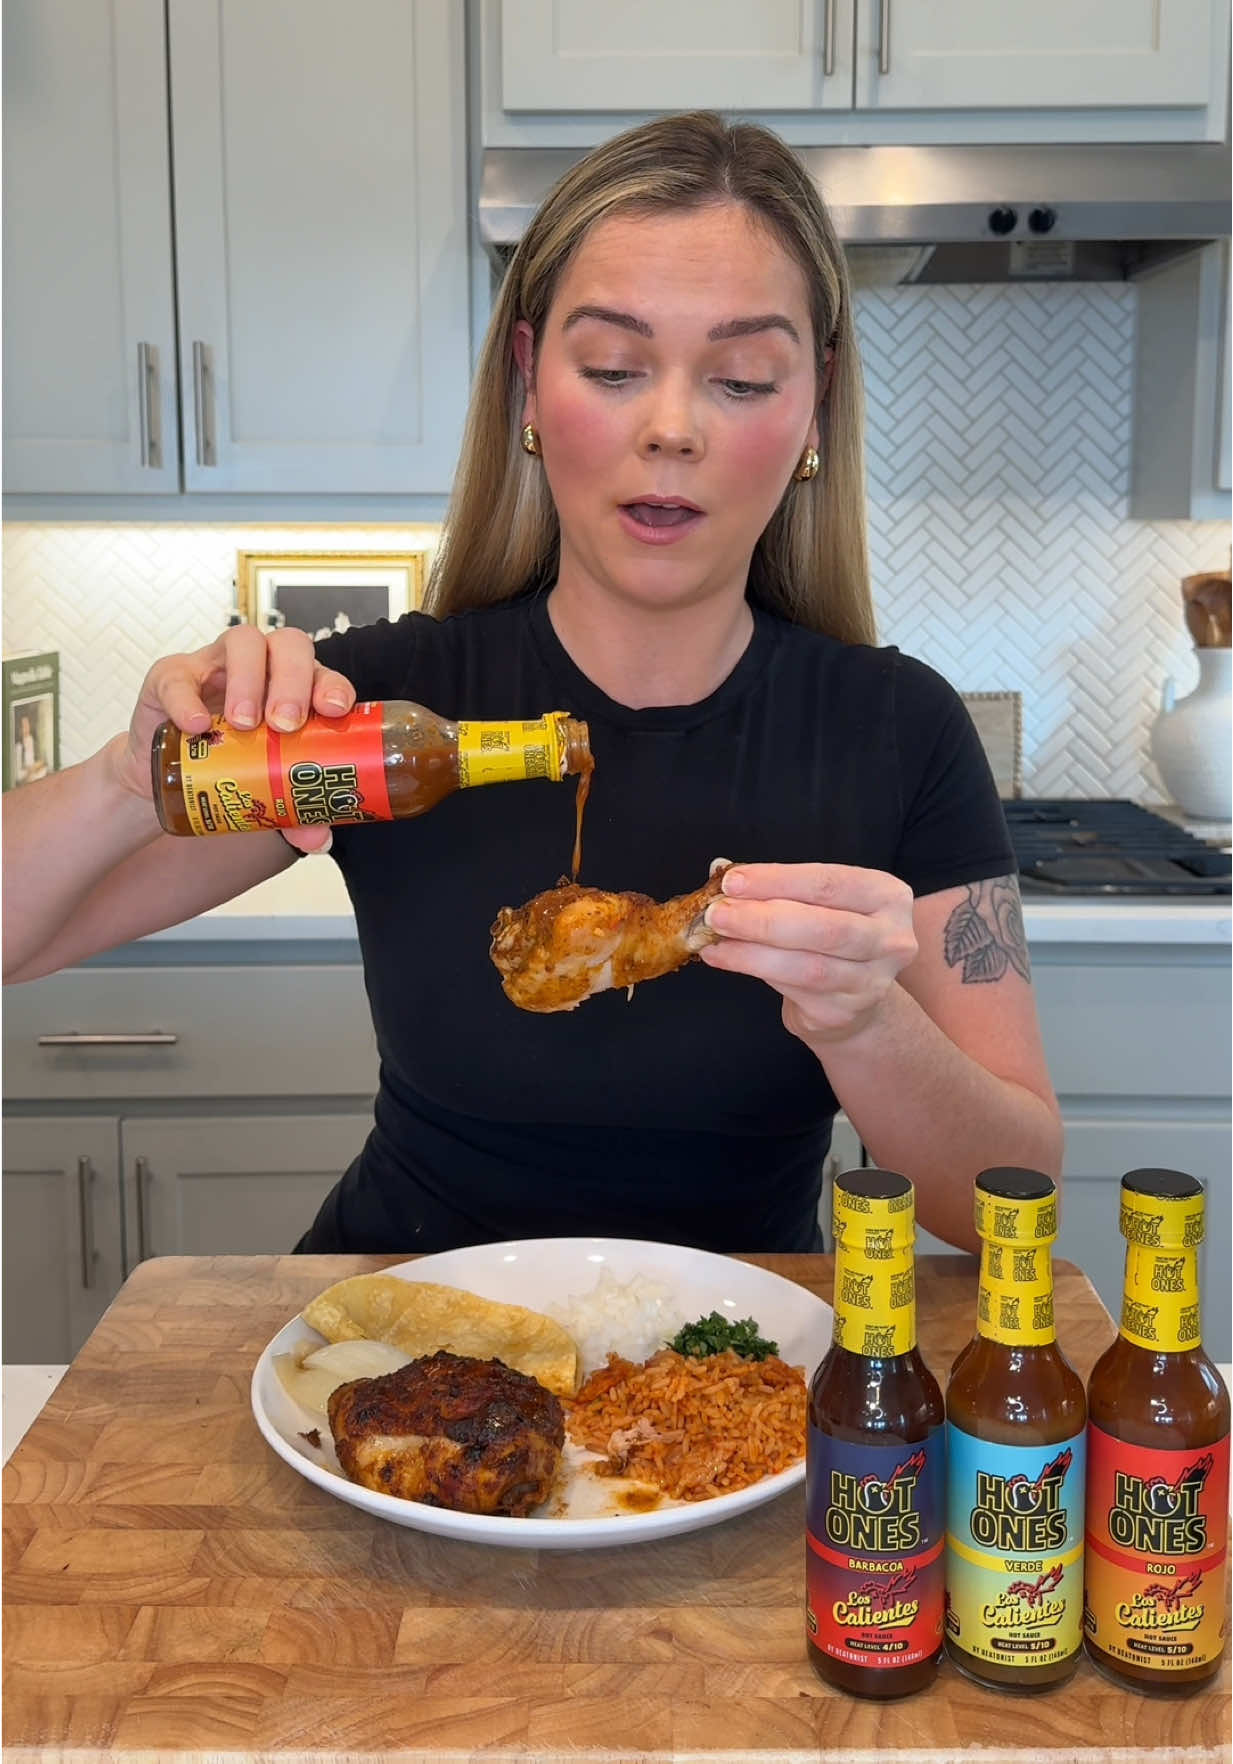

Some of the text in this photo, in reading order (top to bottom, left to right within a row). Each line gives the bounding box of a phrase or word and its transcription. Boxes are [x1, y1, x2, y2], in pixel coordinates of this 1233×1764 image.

[1154, 1264, 1183, 1279] HOT
[1151, 1278, 1184, 1293] ONES
[841, 1288, 871, 1309] ONES
[864, 1332, 893, 1346] HOT
[862, 1345, 895, 1358] ONES
[830, 1469, 918, 1514] HOT
[977, 1470, 1064, 1514] HOT
[1115, 1471, 1204, 1517] HOT
[825, 1506, 921, 1551] ONES
[970, 1506, 1068, 1552] ONES
[1108, 1507, 1207, 1555] ONES
[847, 1558, 904, 1573] BARBACOA
[1005, 1560, 1043, 1573] VERDE
[1146, 1562, 1177, 1576] ROJO
[847, 1591, 872, 1607] Los
[993, 1592, 1020, 1608] Los
[1130, 1592, 1157, 1609] Los
[832, 1599, 919, 1628] Calientes
[980, 1599, 1067, 1629] Calientes
[1115, 1602, 1206, 1630] Calientes
[882, 1642, 904, 1652] 4/10
[1030, 1641, 1050, 1651] 5/10
[1166, 1644, 1188, 1655] 5/10
